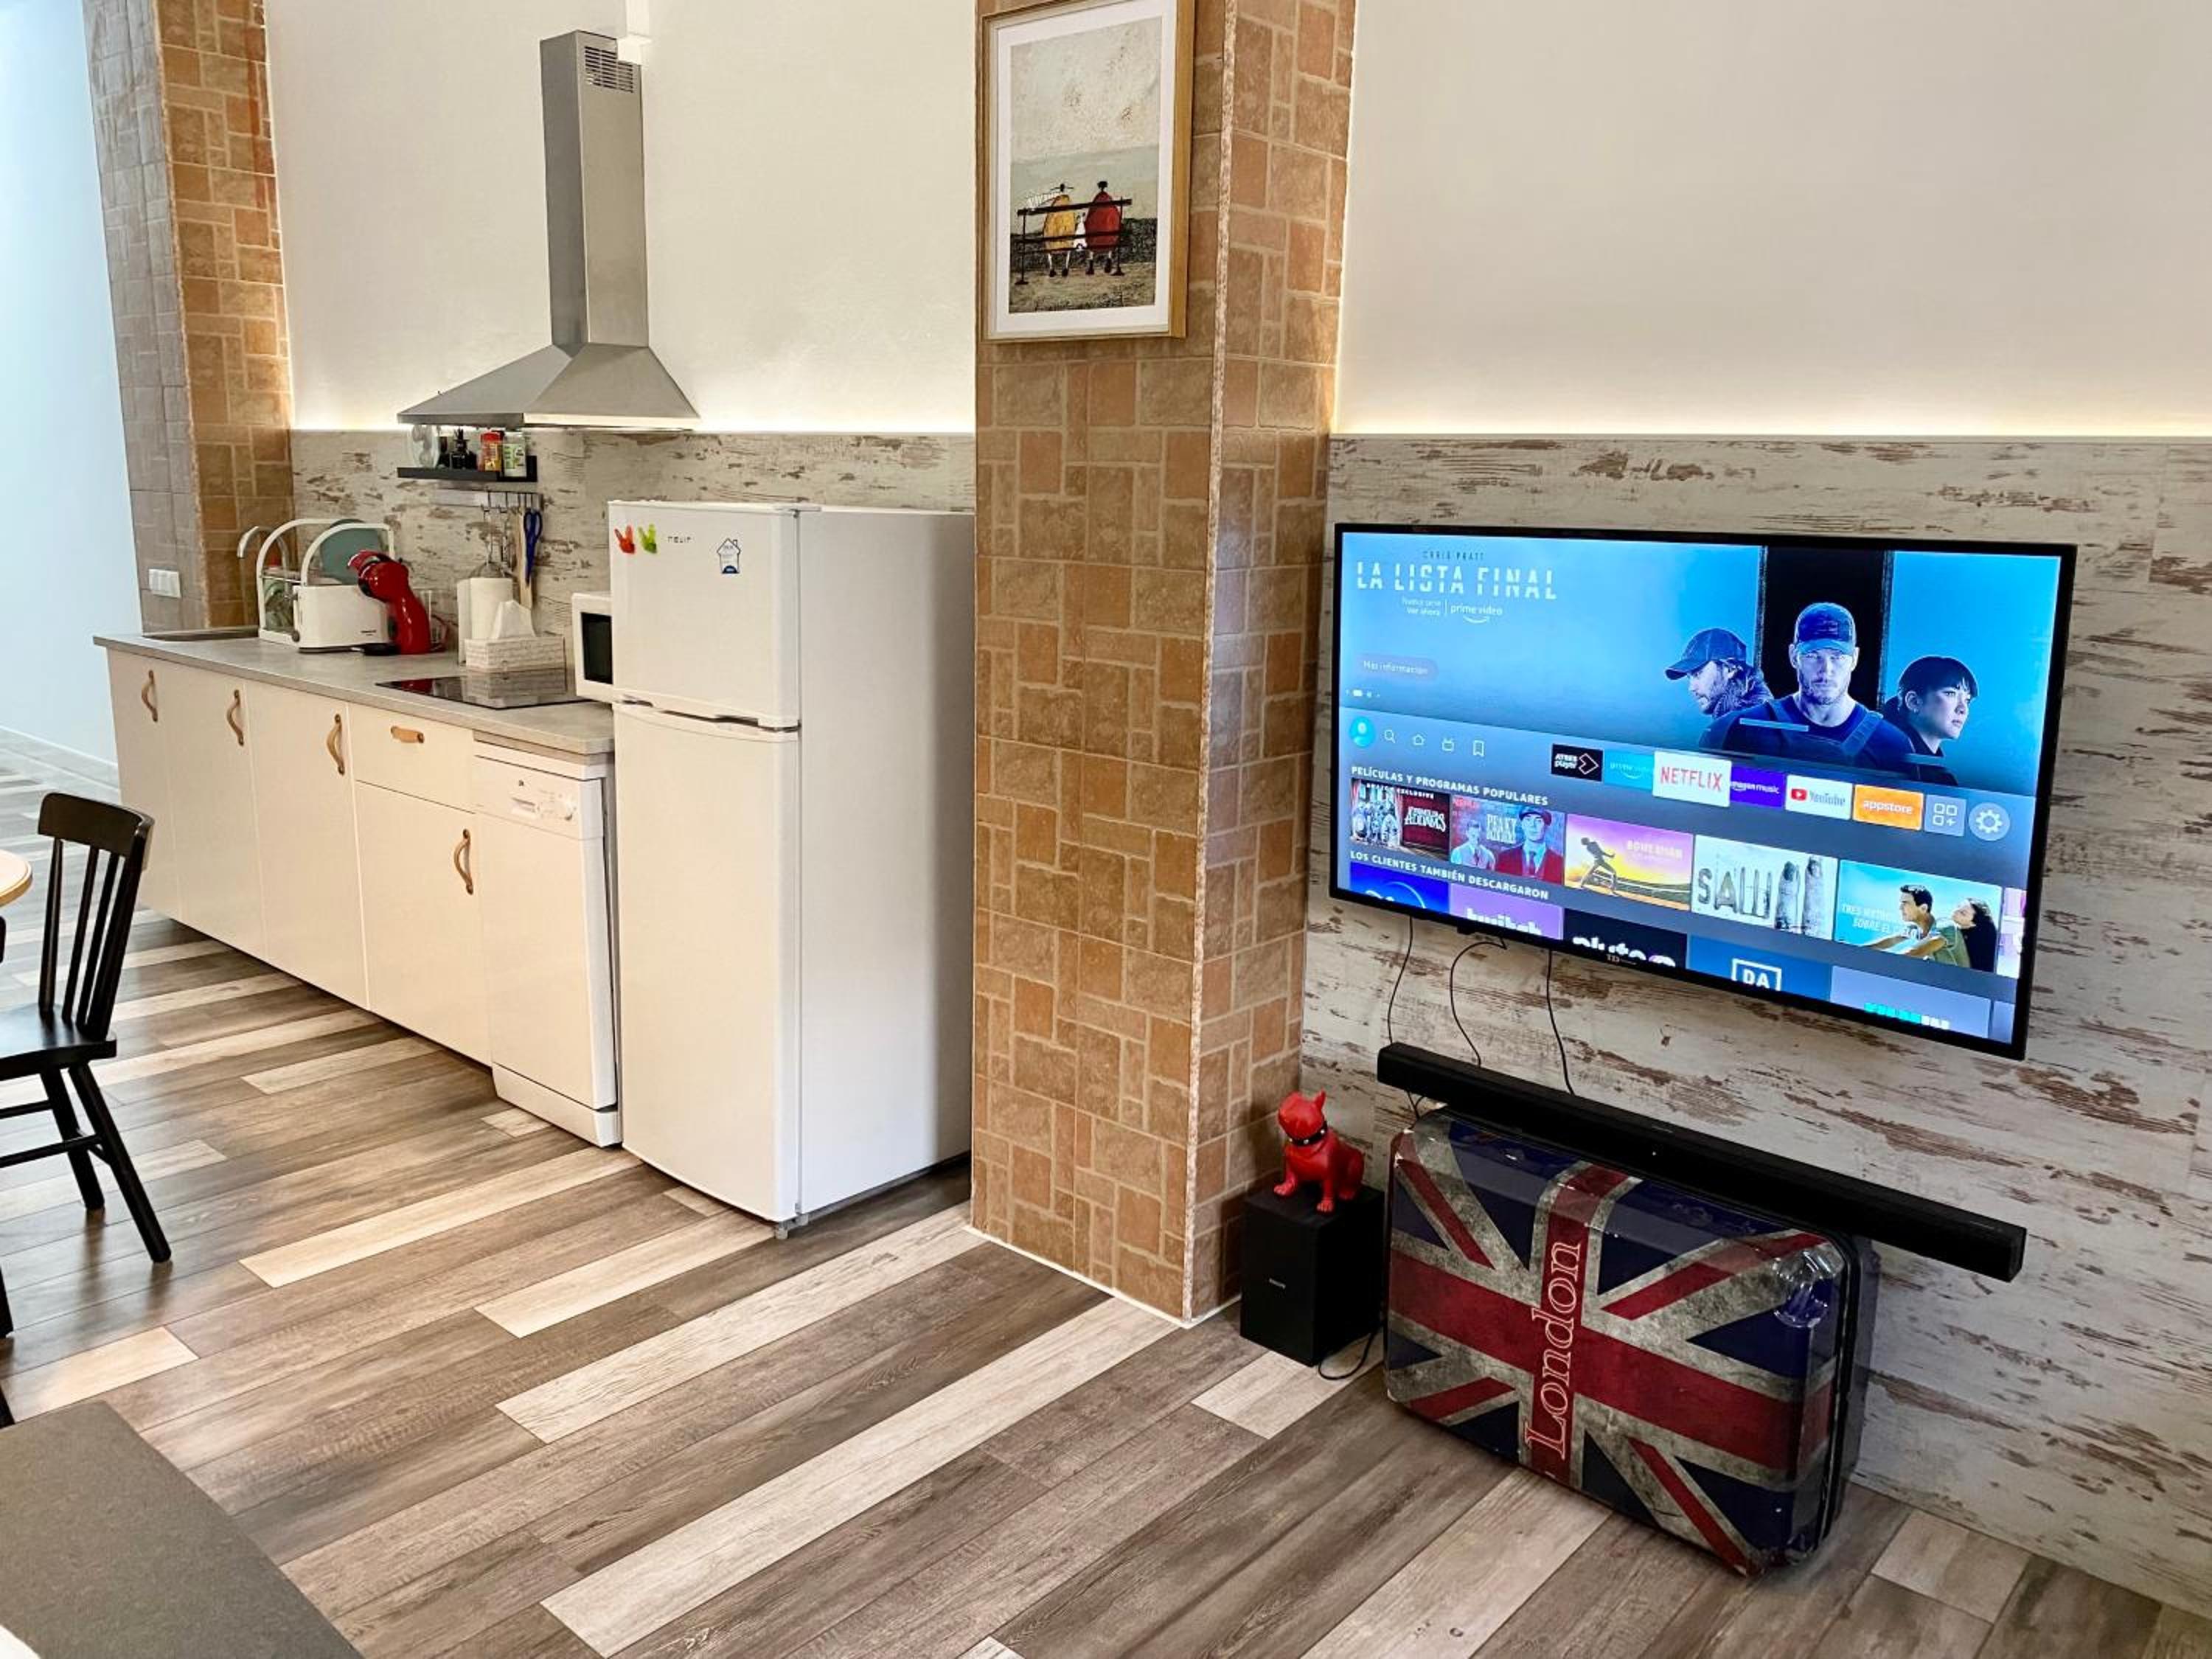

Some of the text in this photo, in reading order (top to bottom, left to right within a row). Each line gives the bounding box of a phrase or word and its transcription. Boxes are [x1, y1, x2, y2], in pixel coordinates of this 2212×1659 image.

[1357, 561, 1557, 599] LA LISTA FINAL
[1450, 603, 1503, 616] prime video
[1351, 765, 1403, 782] PELÍCULAS
[1406, 775, 1413, 784] Y
[1416, 776, 1480, 795] PROGRAMAS
[1483, 787, 1549, 806] POPULARES
[1660, 766, 1723, 792] NETFLIX
[1809, 789, 1846, 807] YouTube
[1863, 799, 1913, 815] appstore
[1349, 850, 1549, 900] LOS CLIENTES TAMBIÉN DESCARGARON
[1742, 968, 1770, 990] DA
[1524, 1241, 1581, 1461] London
